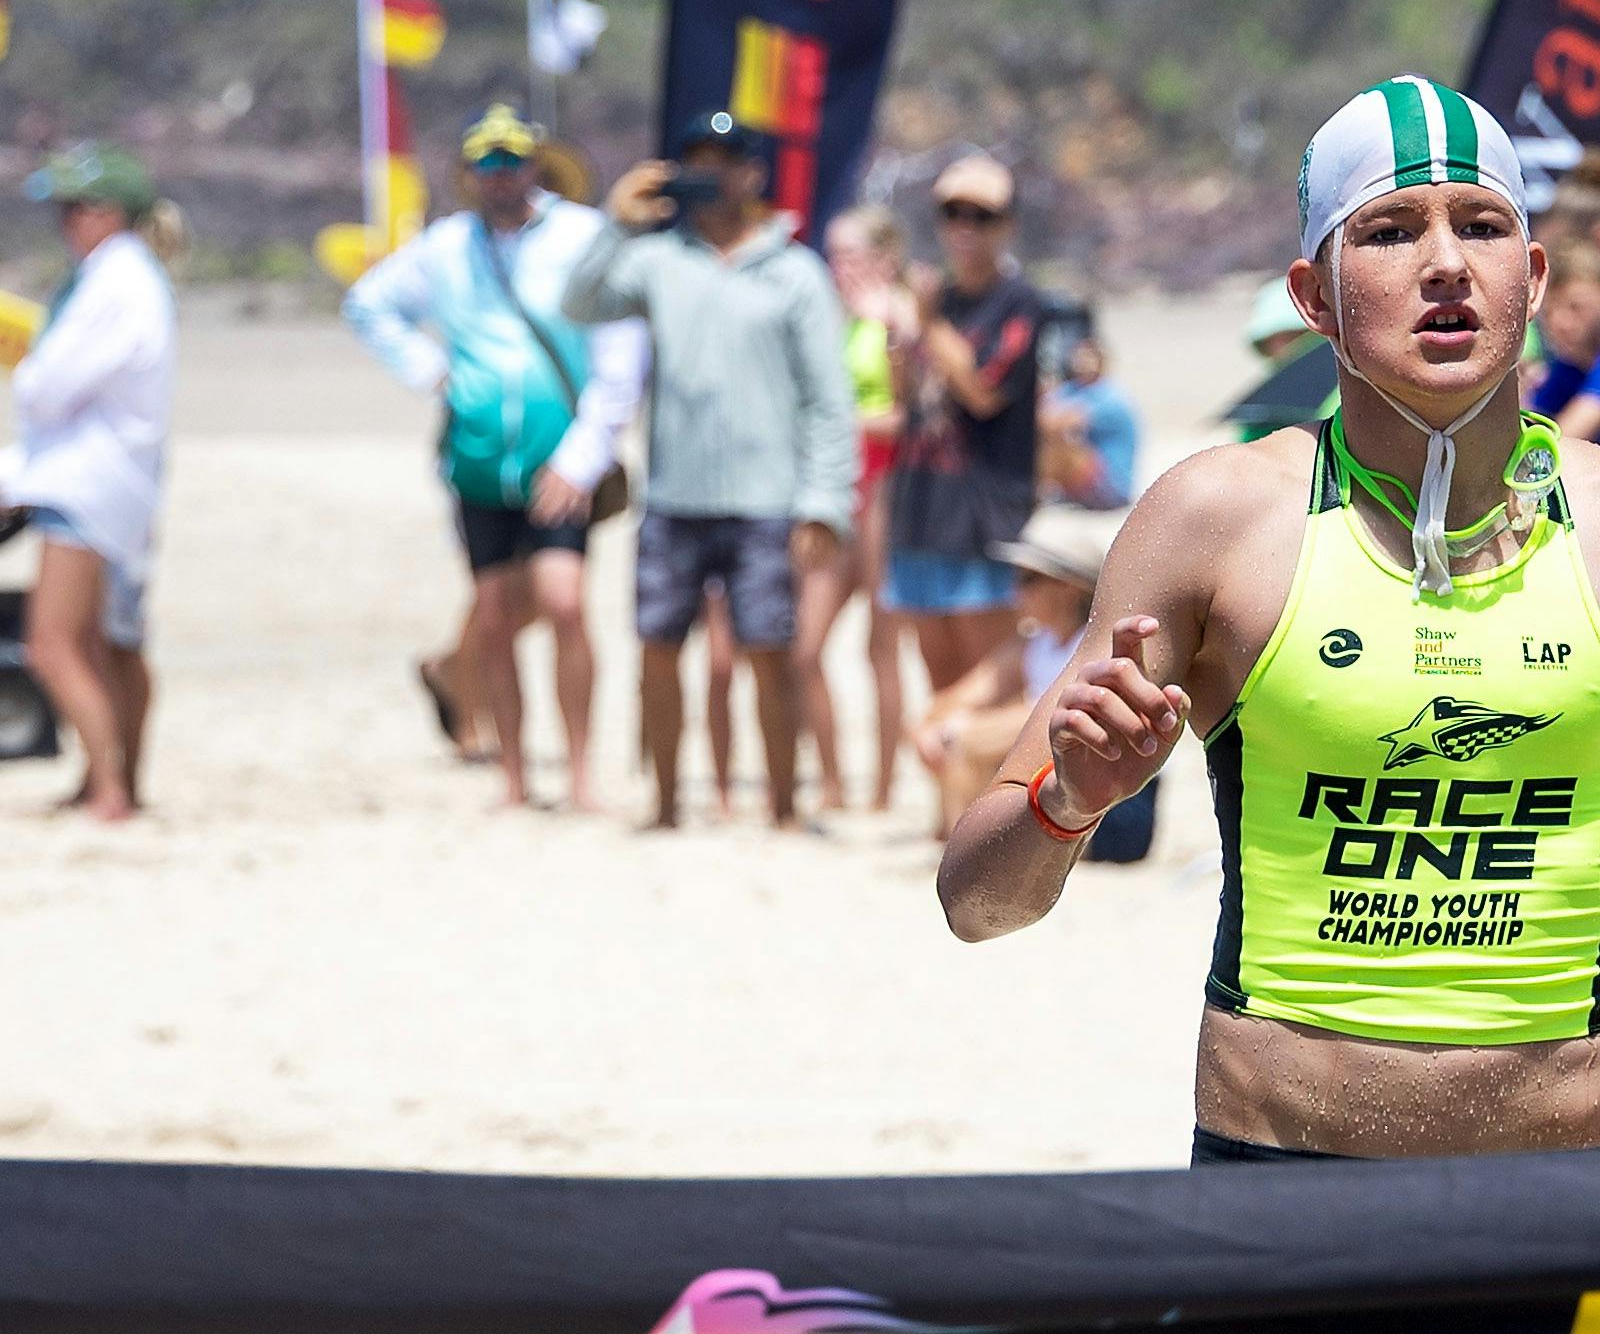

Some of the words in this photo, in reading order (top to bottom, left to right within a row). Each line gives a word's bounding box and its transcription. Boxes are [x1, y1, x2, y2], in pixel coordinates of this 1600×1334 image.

[1414, 626, 1457, 640] Shaw
[1414, 640, 1443, 653] and
[1522, 642, 1572, 664] LAP
[1414, 653, 1482, 667] Partners
[1297, 771, 1579, 827] RACE
[1321, 826, 1540, 880] ONE
[1328, 889, 1419, 919] WORLD
[1430, 892, 1521, 919] YOUTH
[1317, 917, 1525, 947] CHAMPIONSHIP
